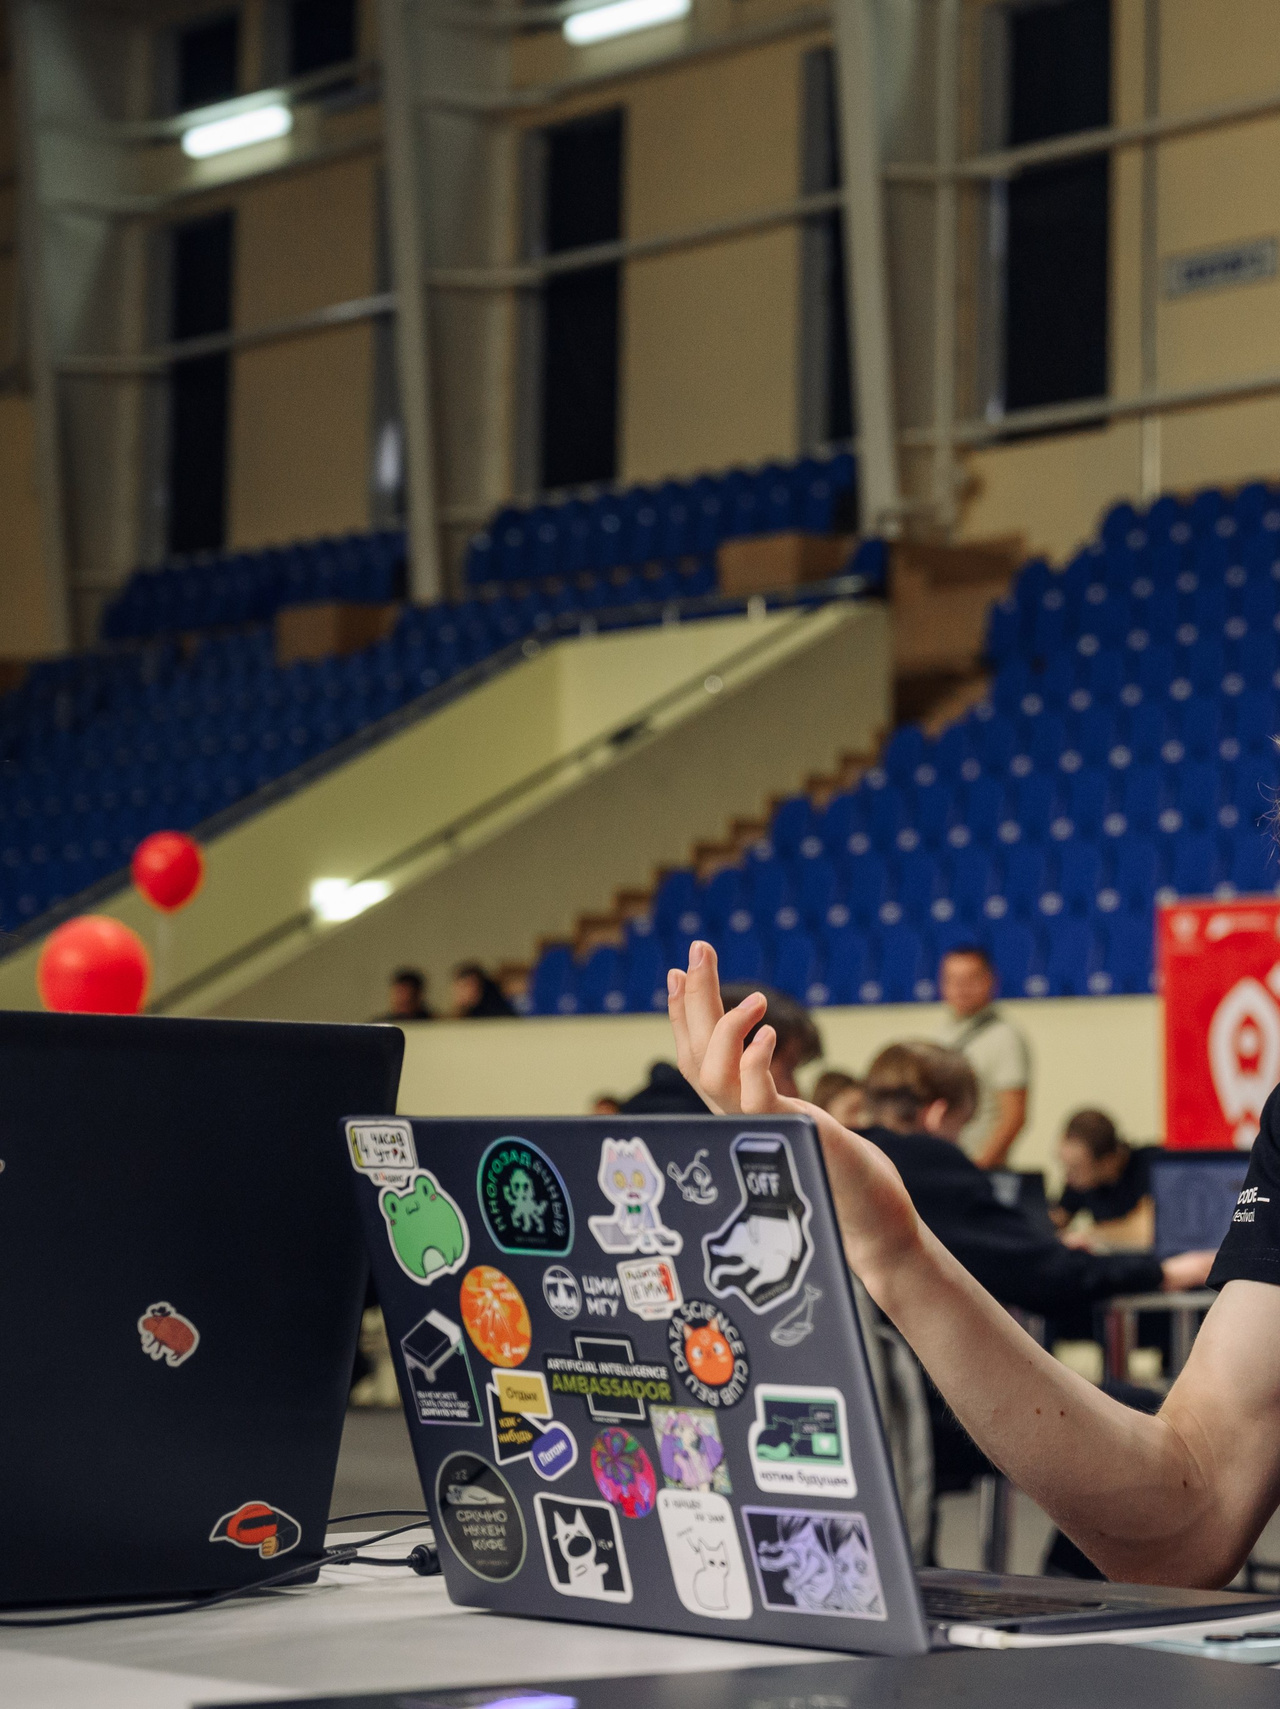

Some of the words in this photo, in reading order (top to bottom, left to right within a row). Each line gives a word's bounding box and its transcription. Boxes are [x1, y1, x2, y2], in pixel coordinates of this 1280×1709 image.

[373, 1148, 407, 1163] УТРА
[746, 1172, 780, 1197] OFF
[582, 1275, 621, 1296] ЦМИ
[586, 1296, 619, 1317] МГУ
[669, 1316, 689, 1373] DATA
[680, 1300, 746, 1356] SCIENCE
[547, 1358, 598, 1374] ARTIFICIAL
[598, 1361, 669, 1380] INTELLIGENCE
[552, 1373, 672, 1402] AMBASSADOR
